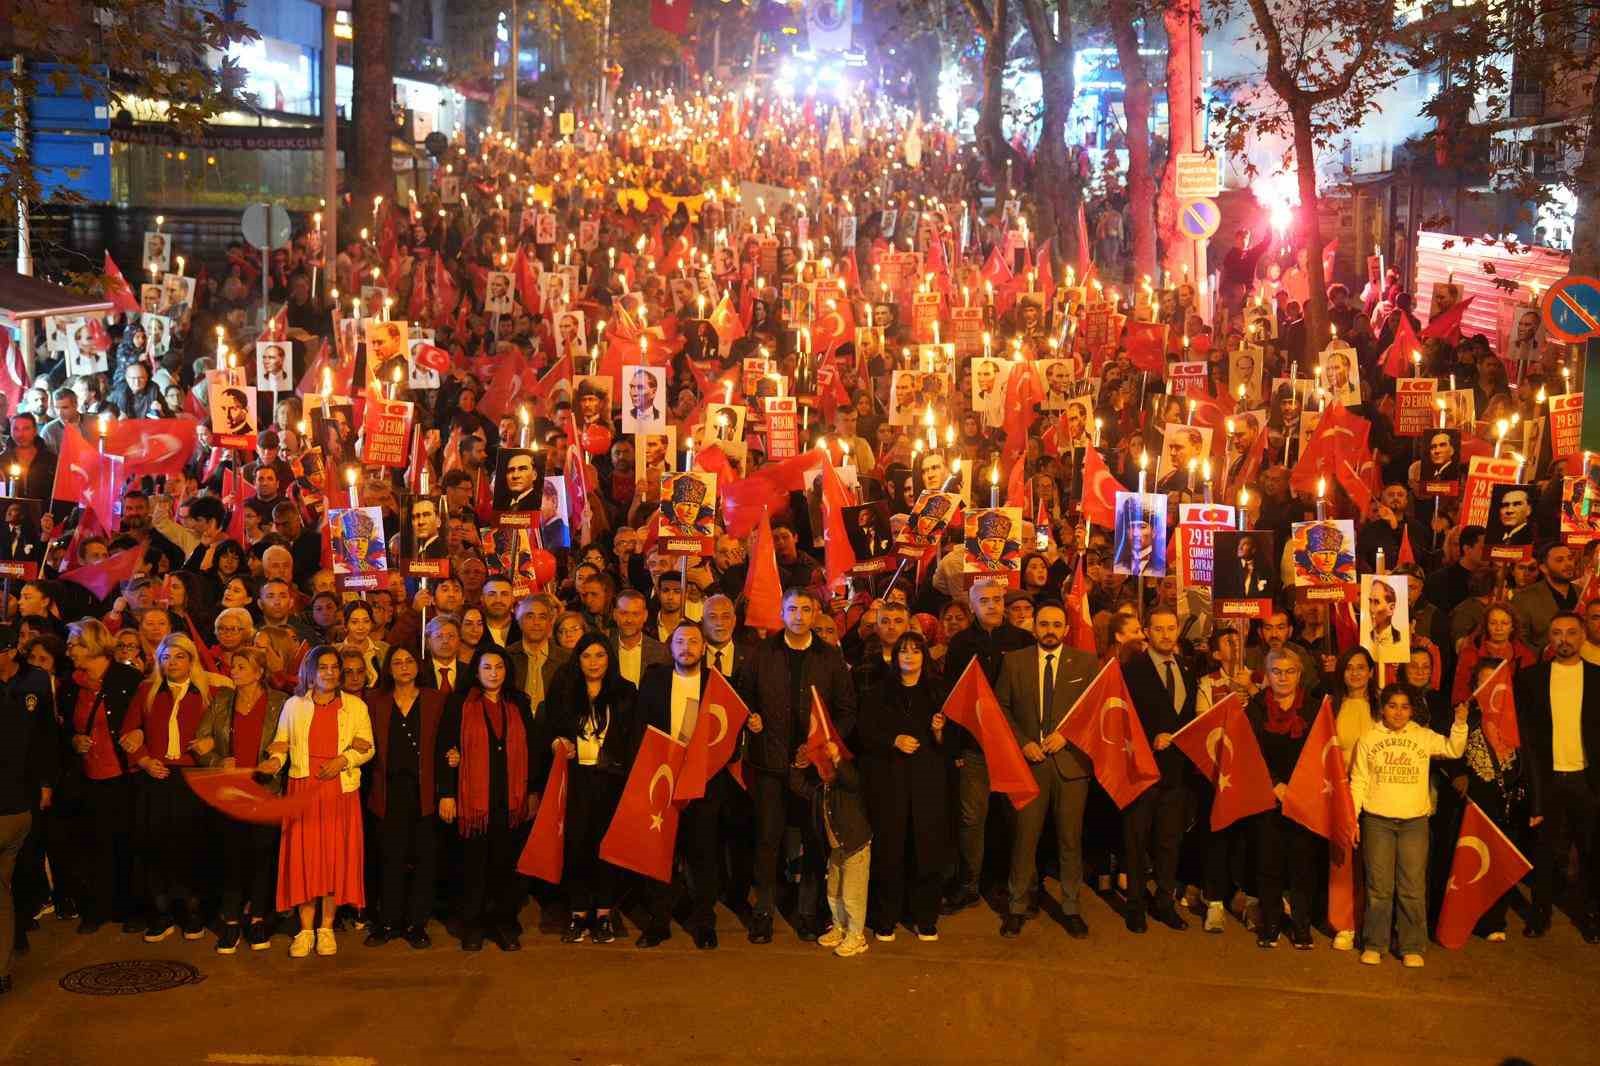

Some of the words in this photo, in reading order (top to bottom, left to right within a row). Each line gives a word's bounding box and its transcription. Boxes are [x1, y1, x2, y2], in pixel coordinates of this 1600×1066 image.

[1473, 480, 1486, 496] 29
[1188, 528, 1202, 545] 29
[1367, 738, 1418, 760] UNIVERSITY
[1417, 748, 1428, 760] OF
[1375, 766, 1420, 776] CALIFORNIA
